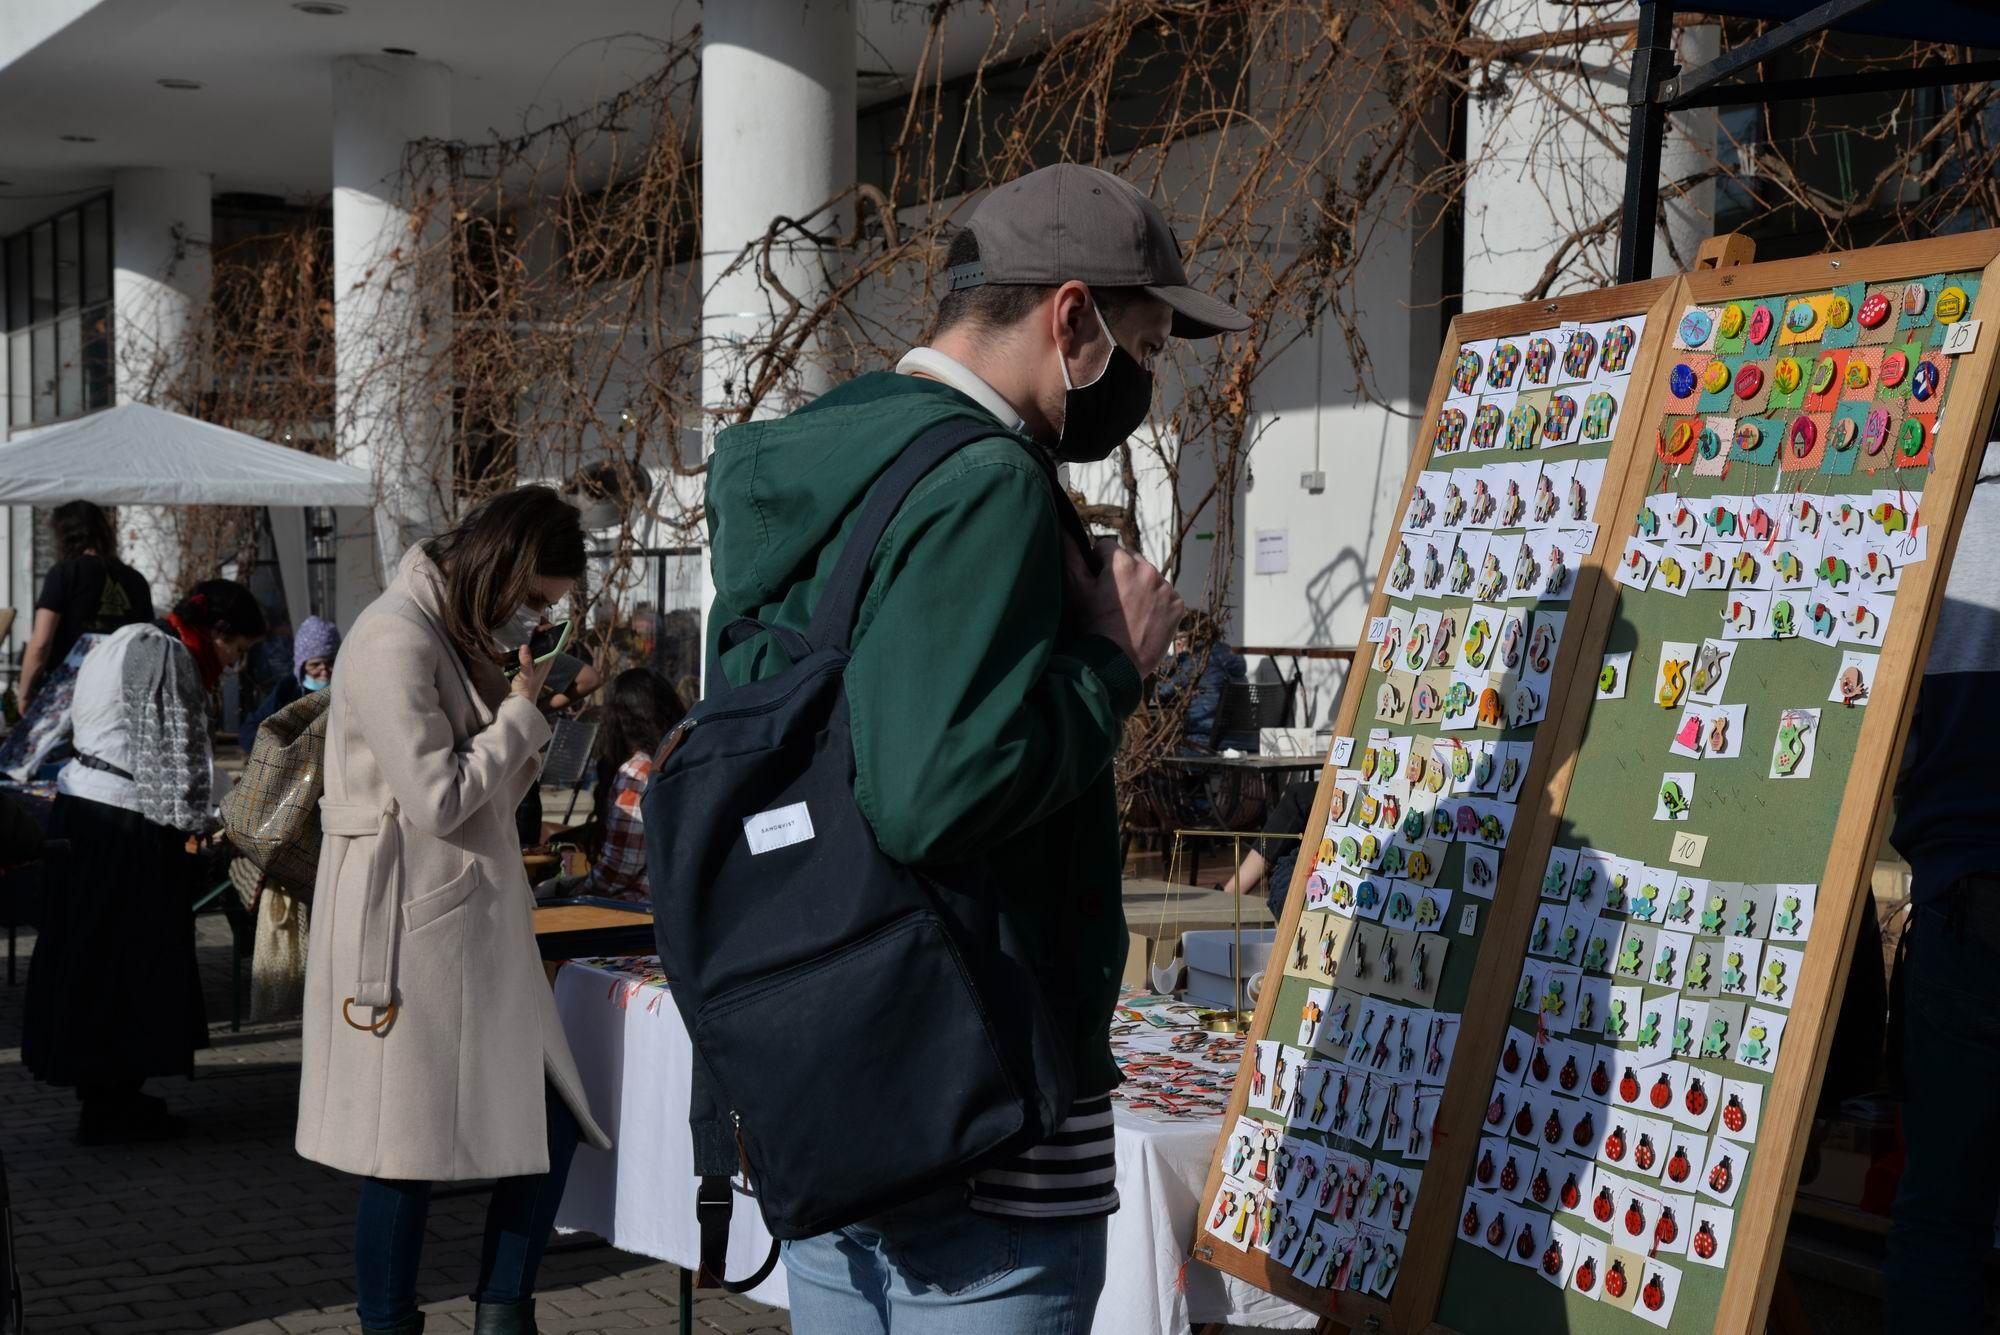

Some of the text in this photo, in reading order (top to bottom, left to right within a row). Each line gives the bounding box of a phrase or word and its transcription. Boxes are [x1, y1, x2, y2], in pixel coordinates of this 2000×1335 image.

[1950, 323, 1972, 348] 15
[1574, 528, 1593, 549] 25
[1896, 535, 1918, 557] 10
[1369, 621, 1384, 639] 20
[1334, 741, 1350, 760] 15
[761, 820, 795, 833] SANDQVIST
[1678, 839, 1696, 859] 10
